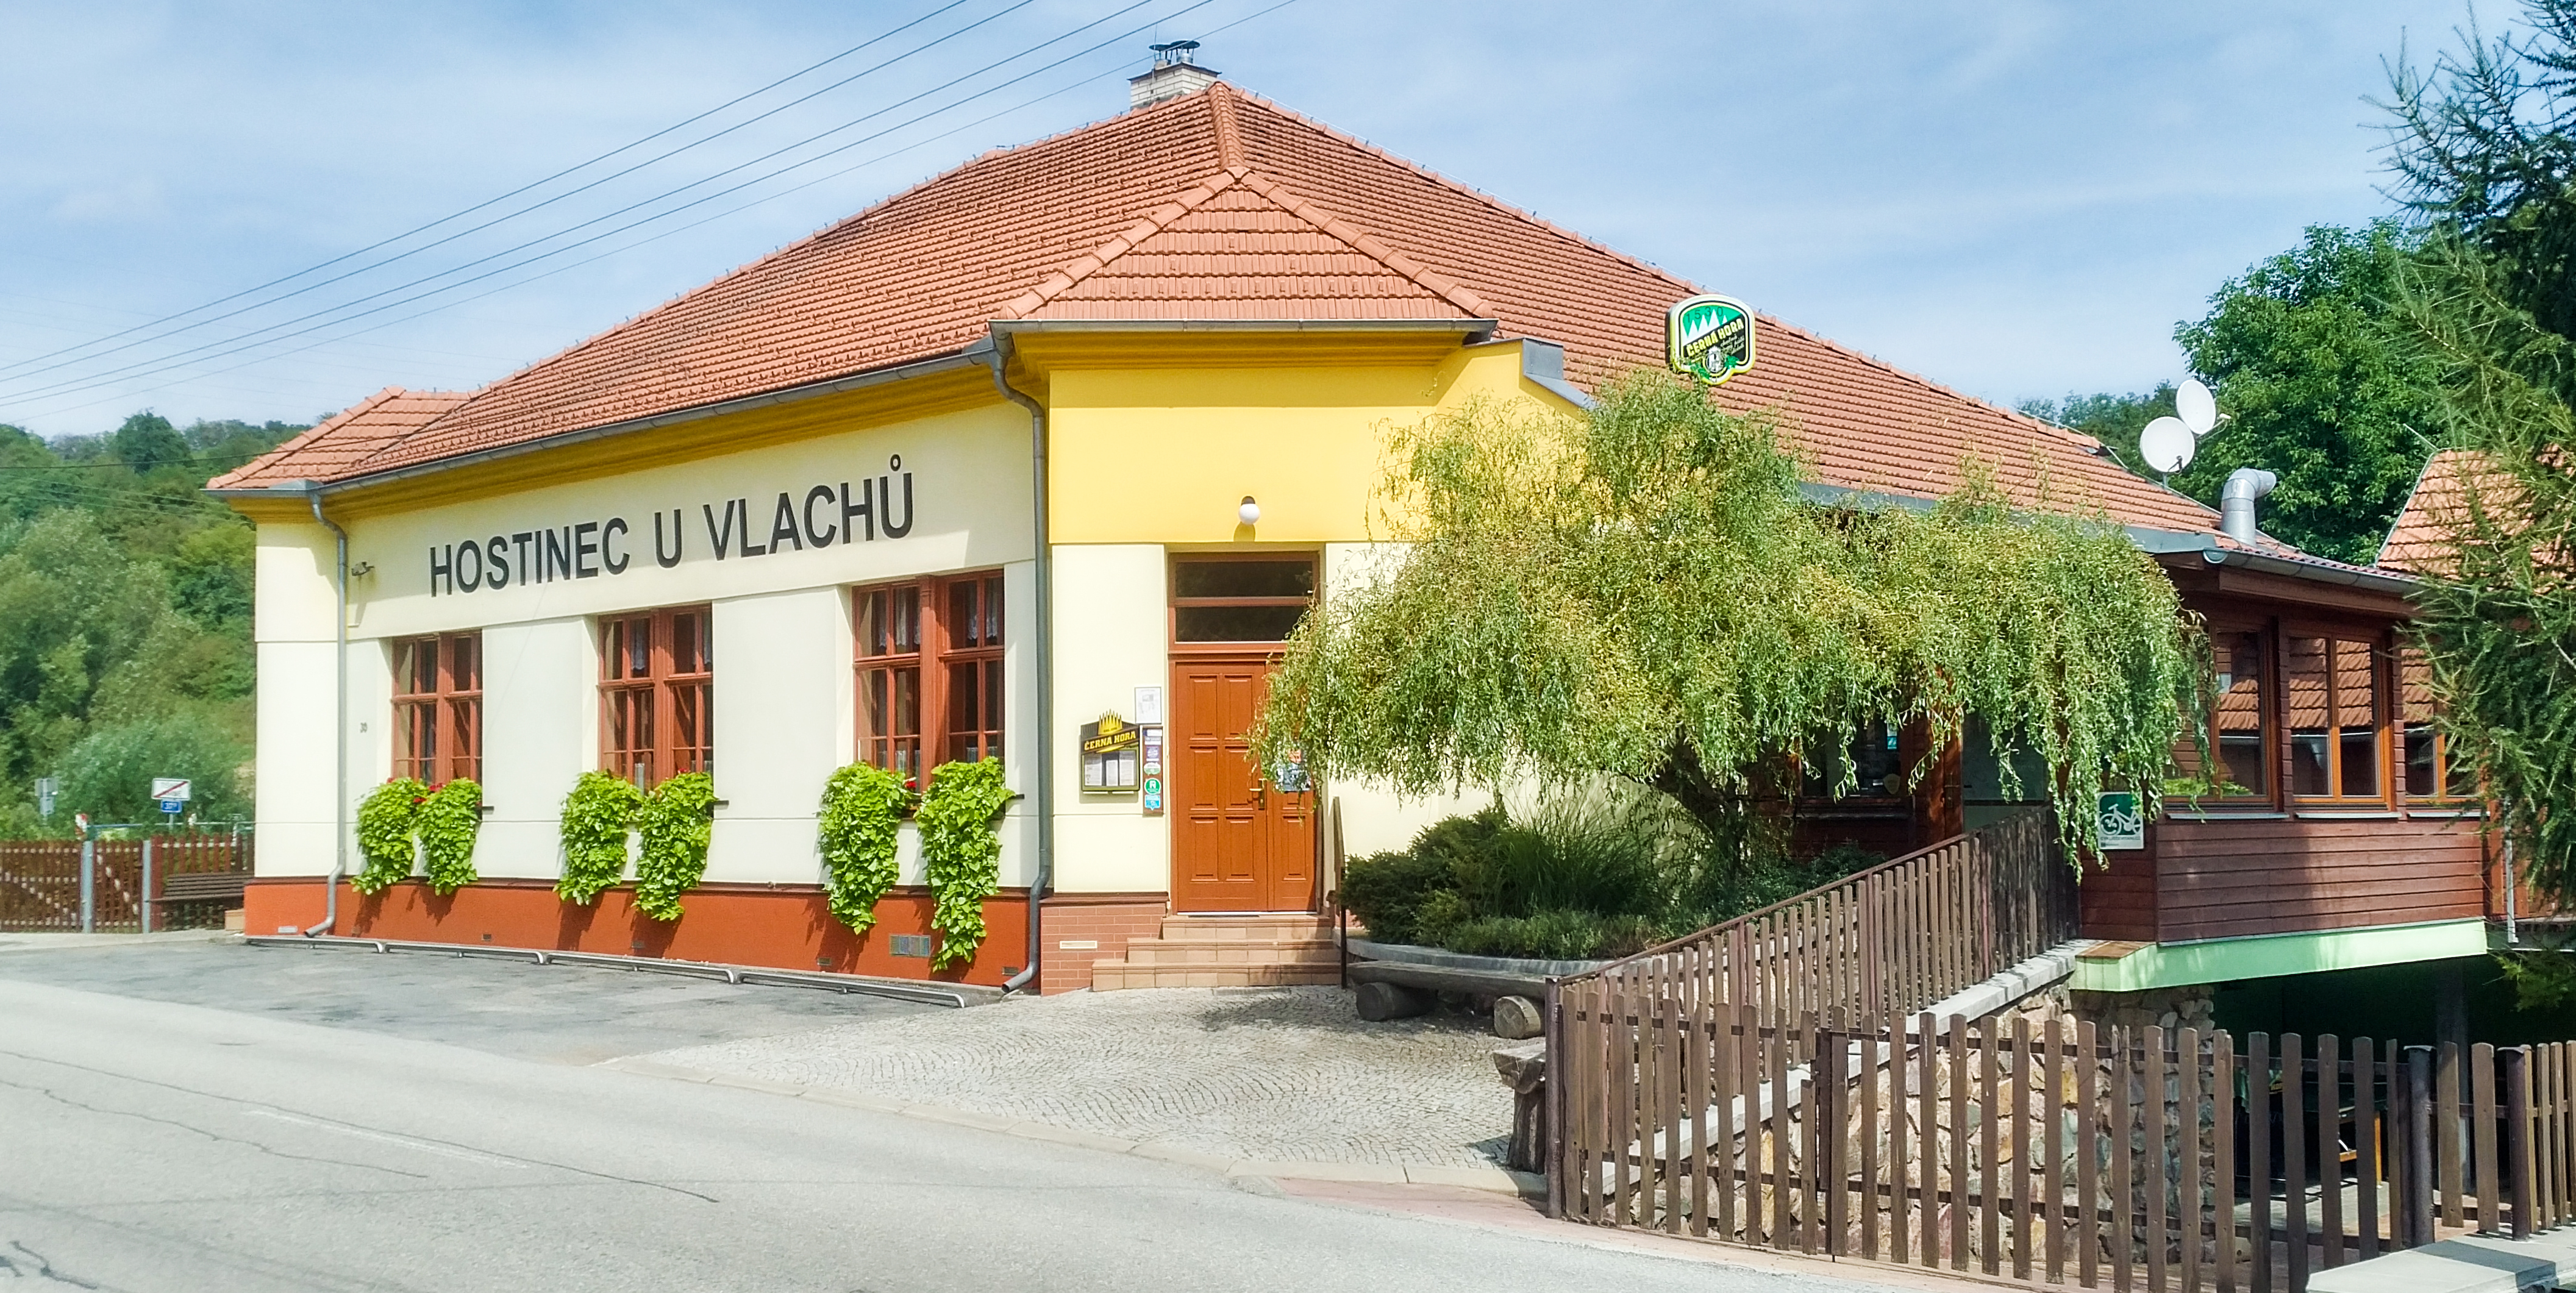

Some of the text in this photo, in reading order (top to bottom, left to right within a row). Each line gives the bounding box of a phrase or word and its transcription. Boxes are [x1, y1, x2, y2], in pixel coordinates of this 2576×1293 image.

[1685, 306, 1723, 323] 1530
[1718, 318, 1744, 339] HORA
[430, 454, 914, 597] HOSTINEC U VLACHŮ
[1084, 731, 1136, 750] ČERNÁ HORA
